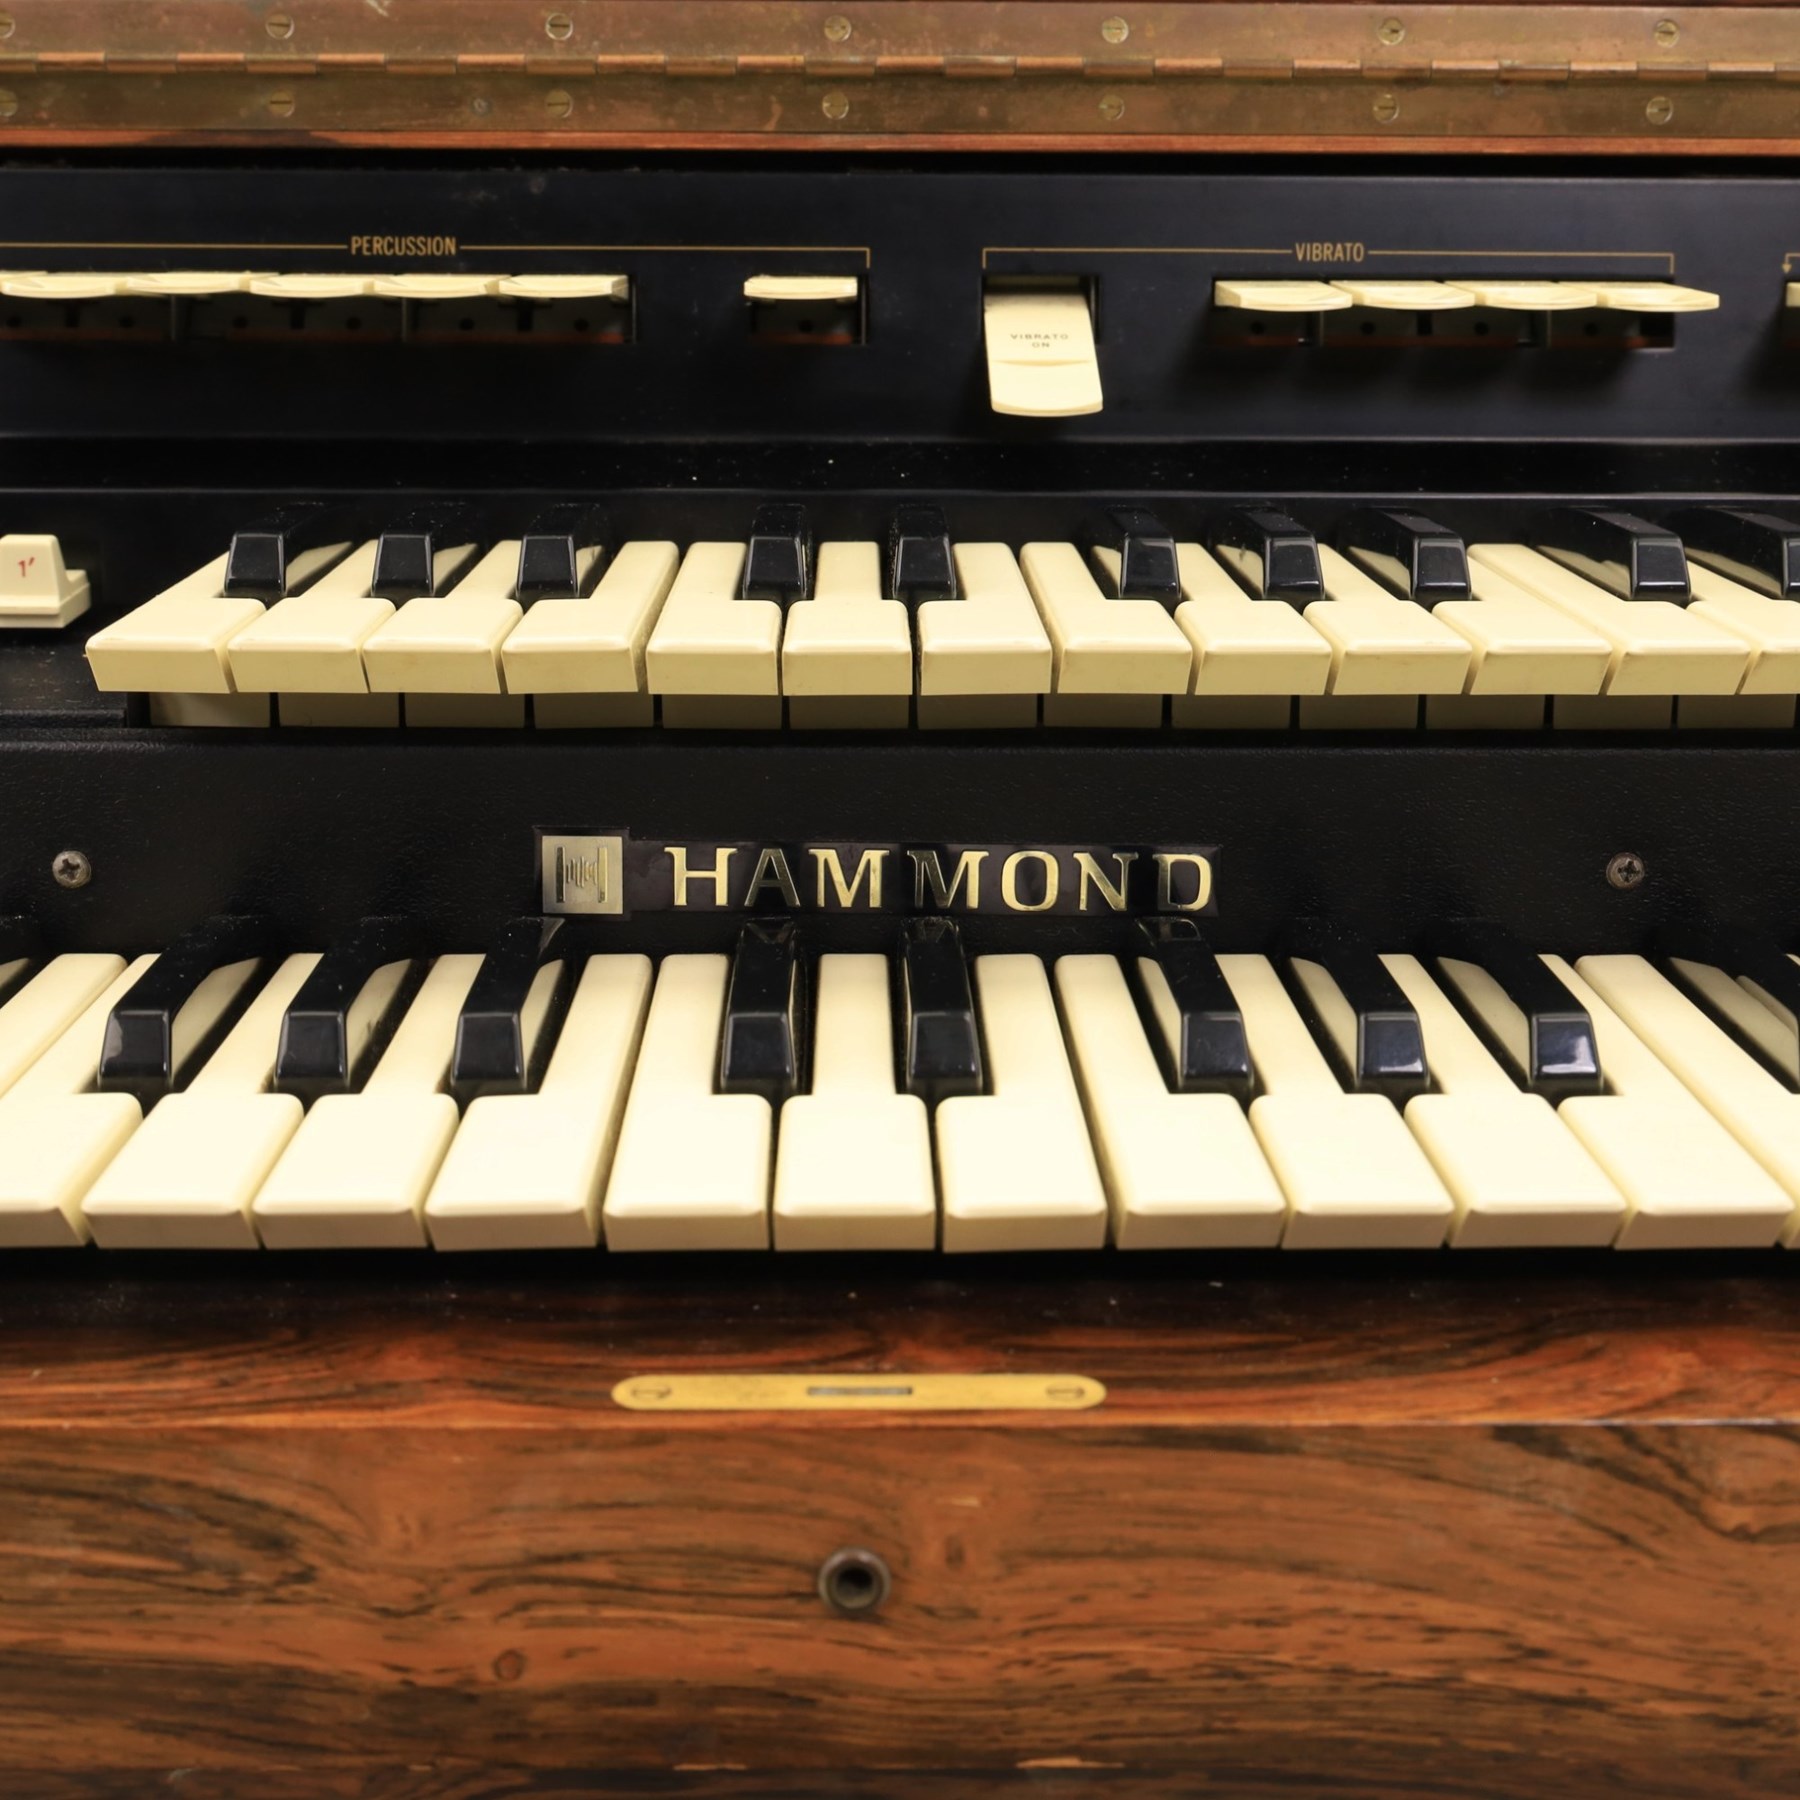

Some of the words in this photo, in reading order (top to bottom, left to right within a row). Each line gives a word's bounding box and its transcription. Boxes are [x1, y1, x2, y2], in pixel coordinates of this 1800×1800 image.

[350, 236, 457, 256] PERCUSSION
[1295, 242, 1365, 262] VIBRATO
[1010, 333, 1069, 341] VIBRATO
[1031, 341, 1051, 349] ON
[663, 846, 1213, 912] HAMMOND
